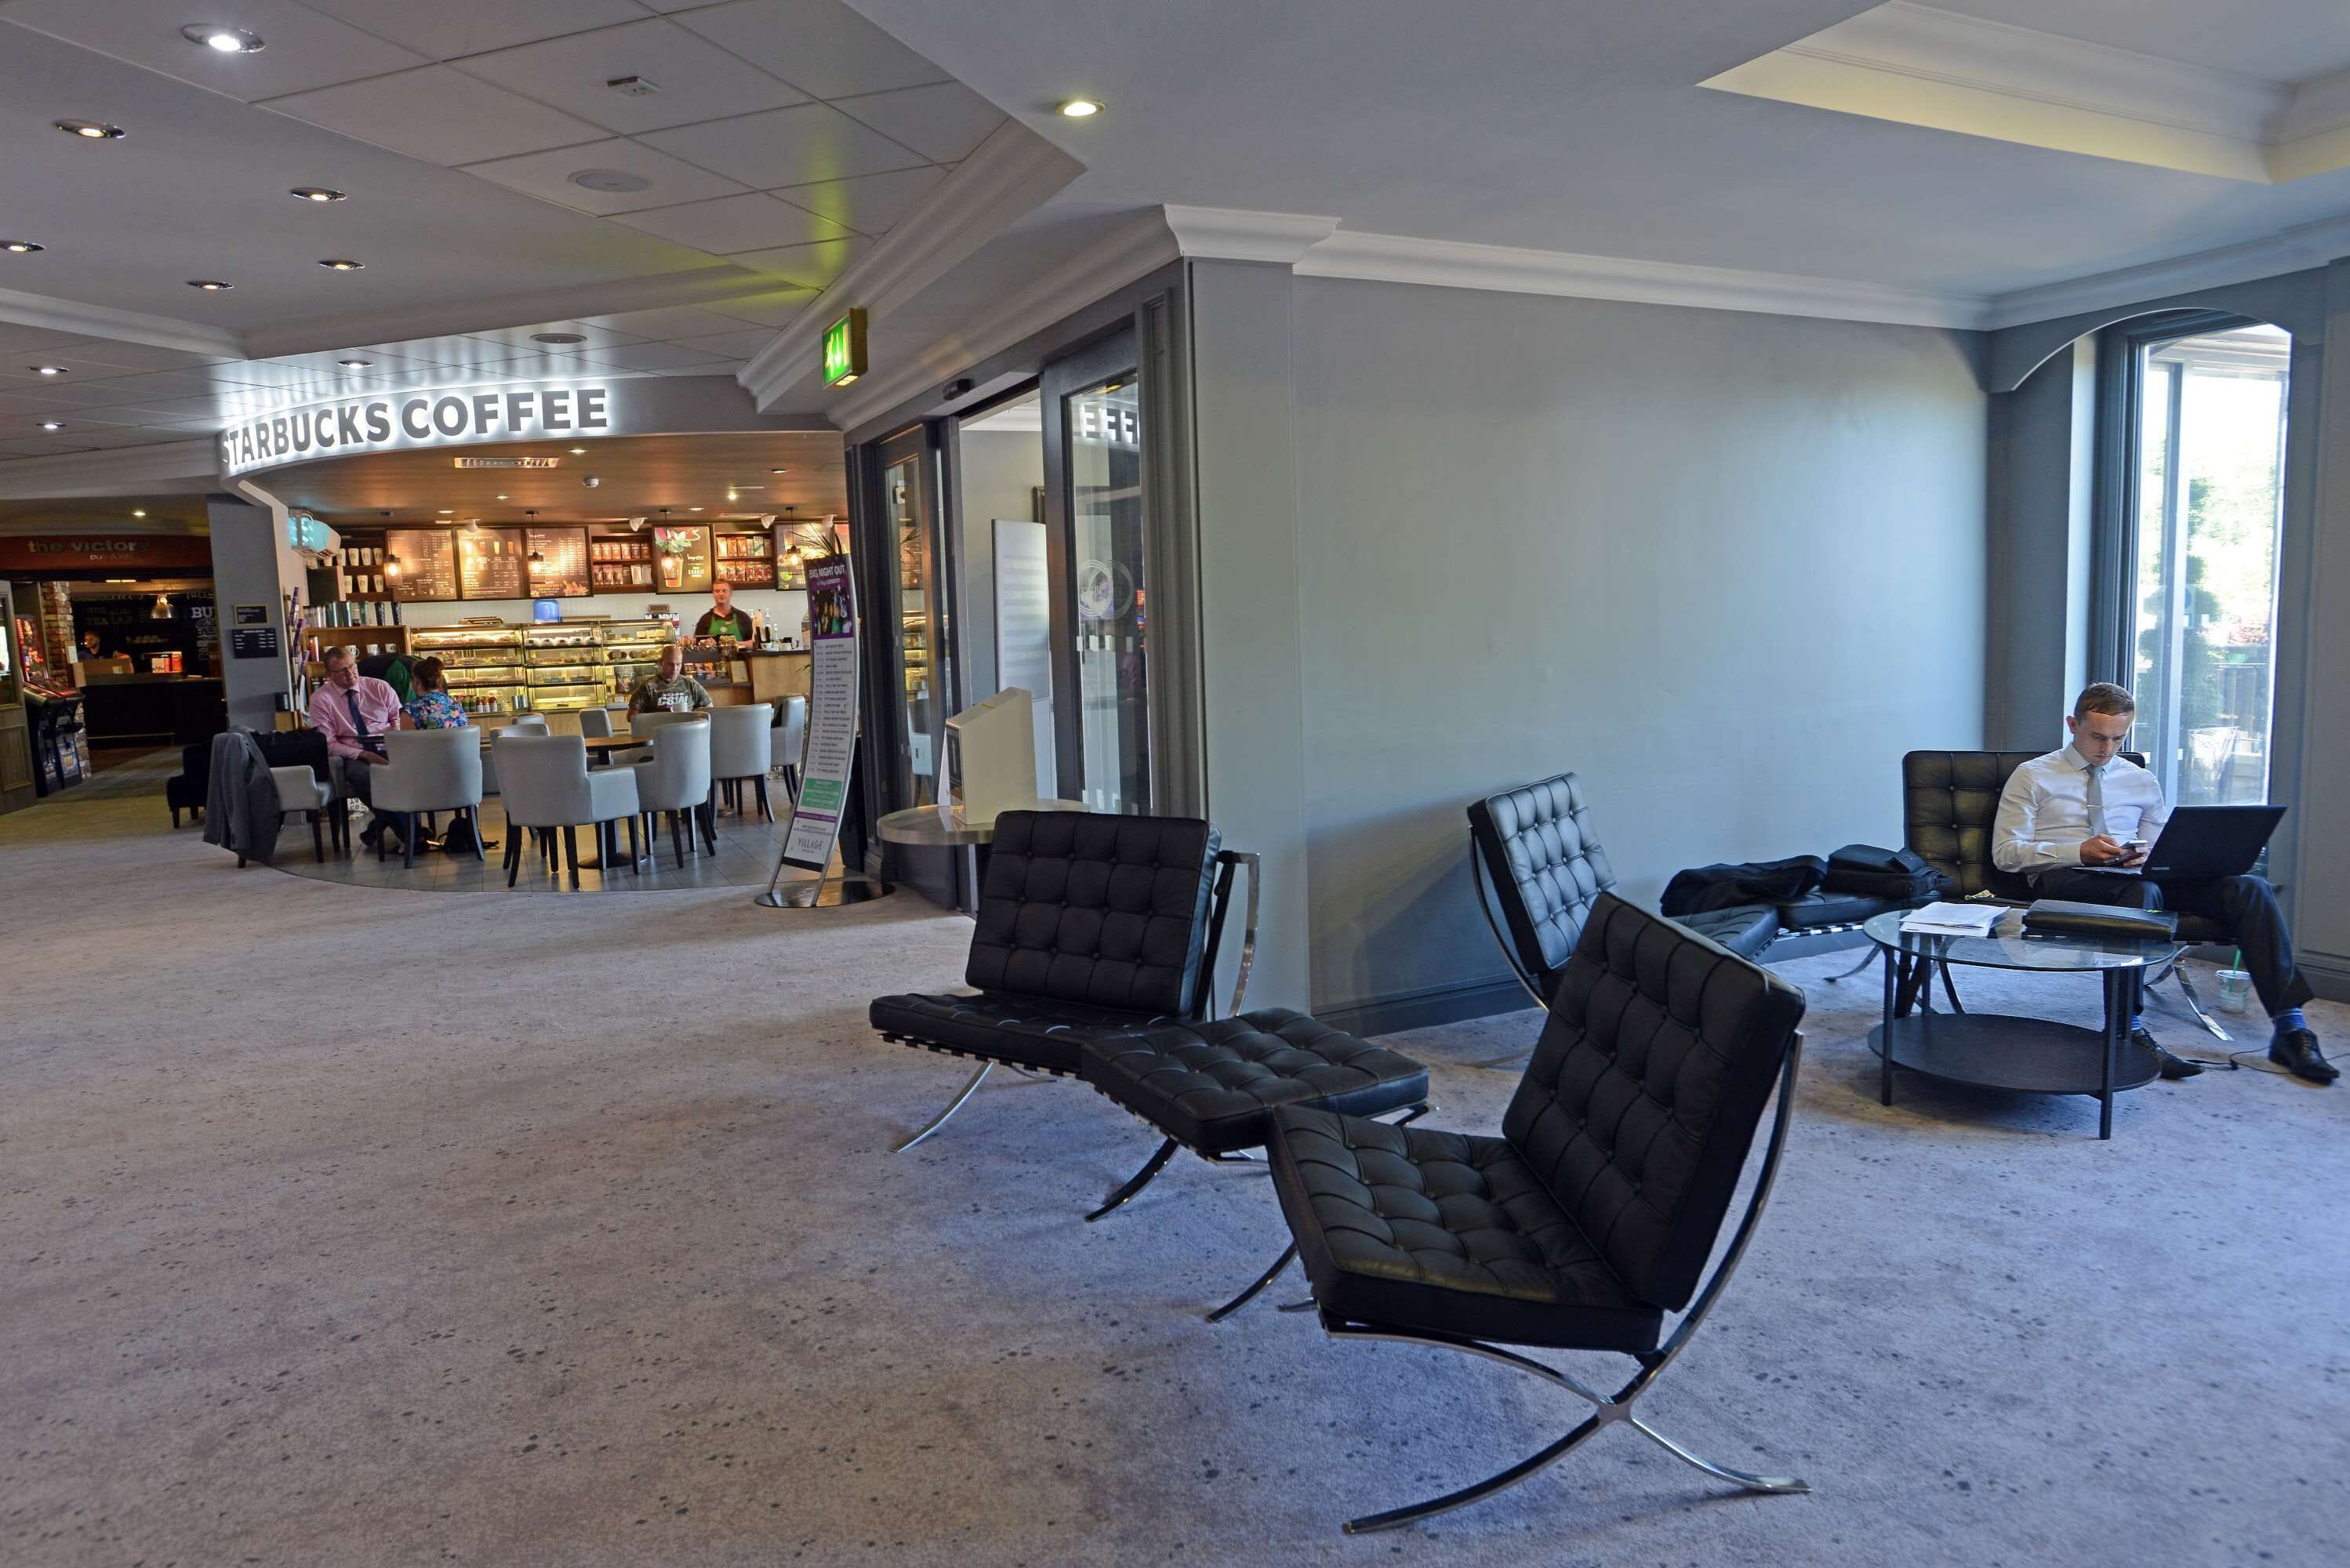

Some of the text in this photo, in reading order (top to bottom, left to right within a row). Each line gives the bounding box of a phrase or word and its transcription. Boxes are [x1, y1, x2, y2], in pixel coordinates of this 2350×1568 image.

[223, 389, 607, 466] STARBUCKS COFFEE
[27, 539, 150, 553] the victory
[819, 566, 834, 577] NIGHT
[834, 564, 844, 575] OUT
[797, 837, 823, 851] VILLAGE
